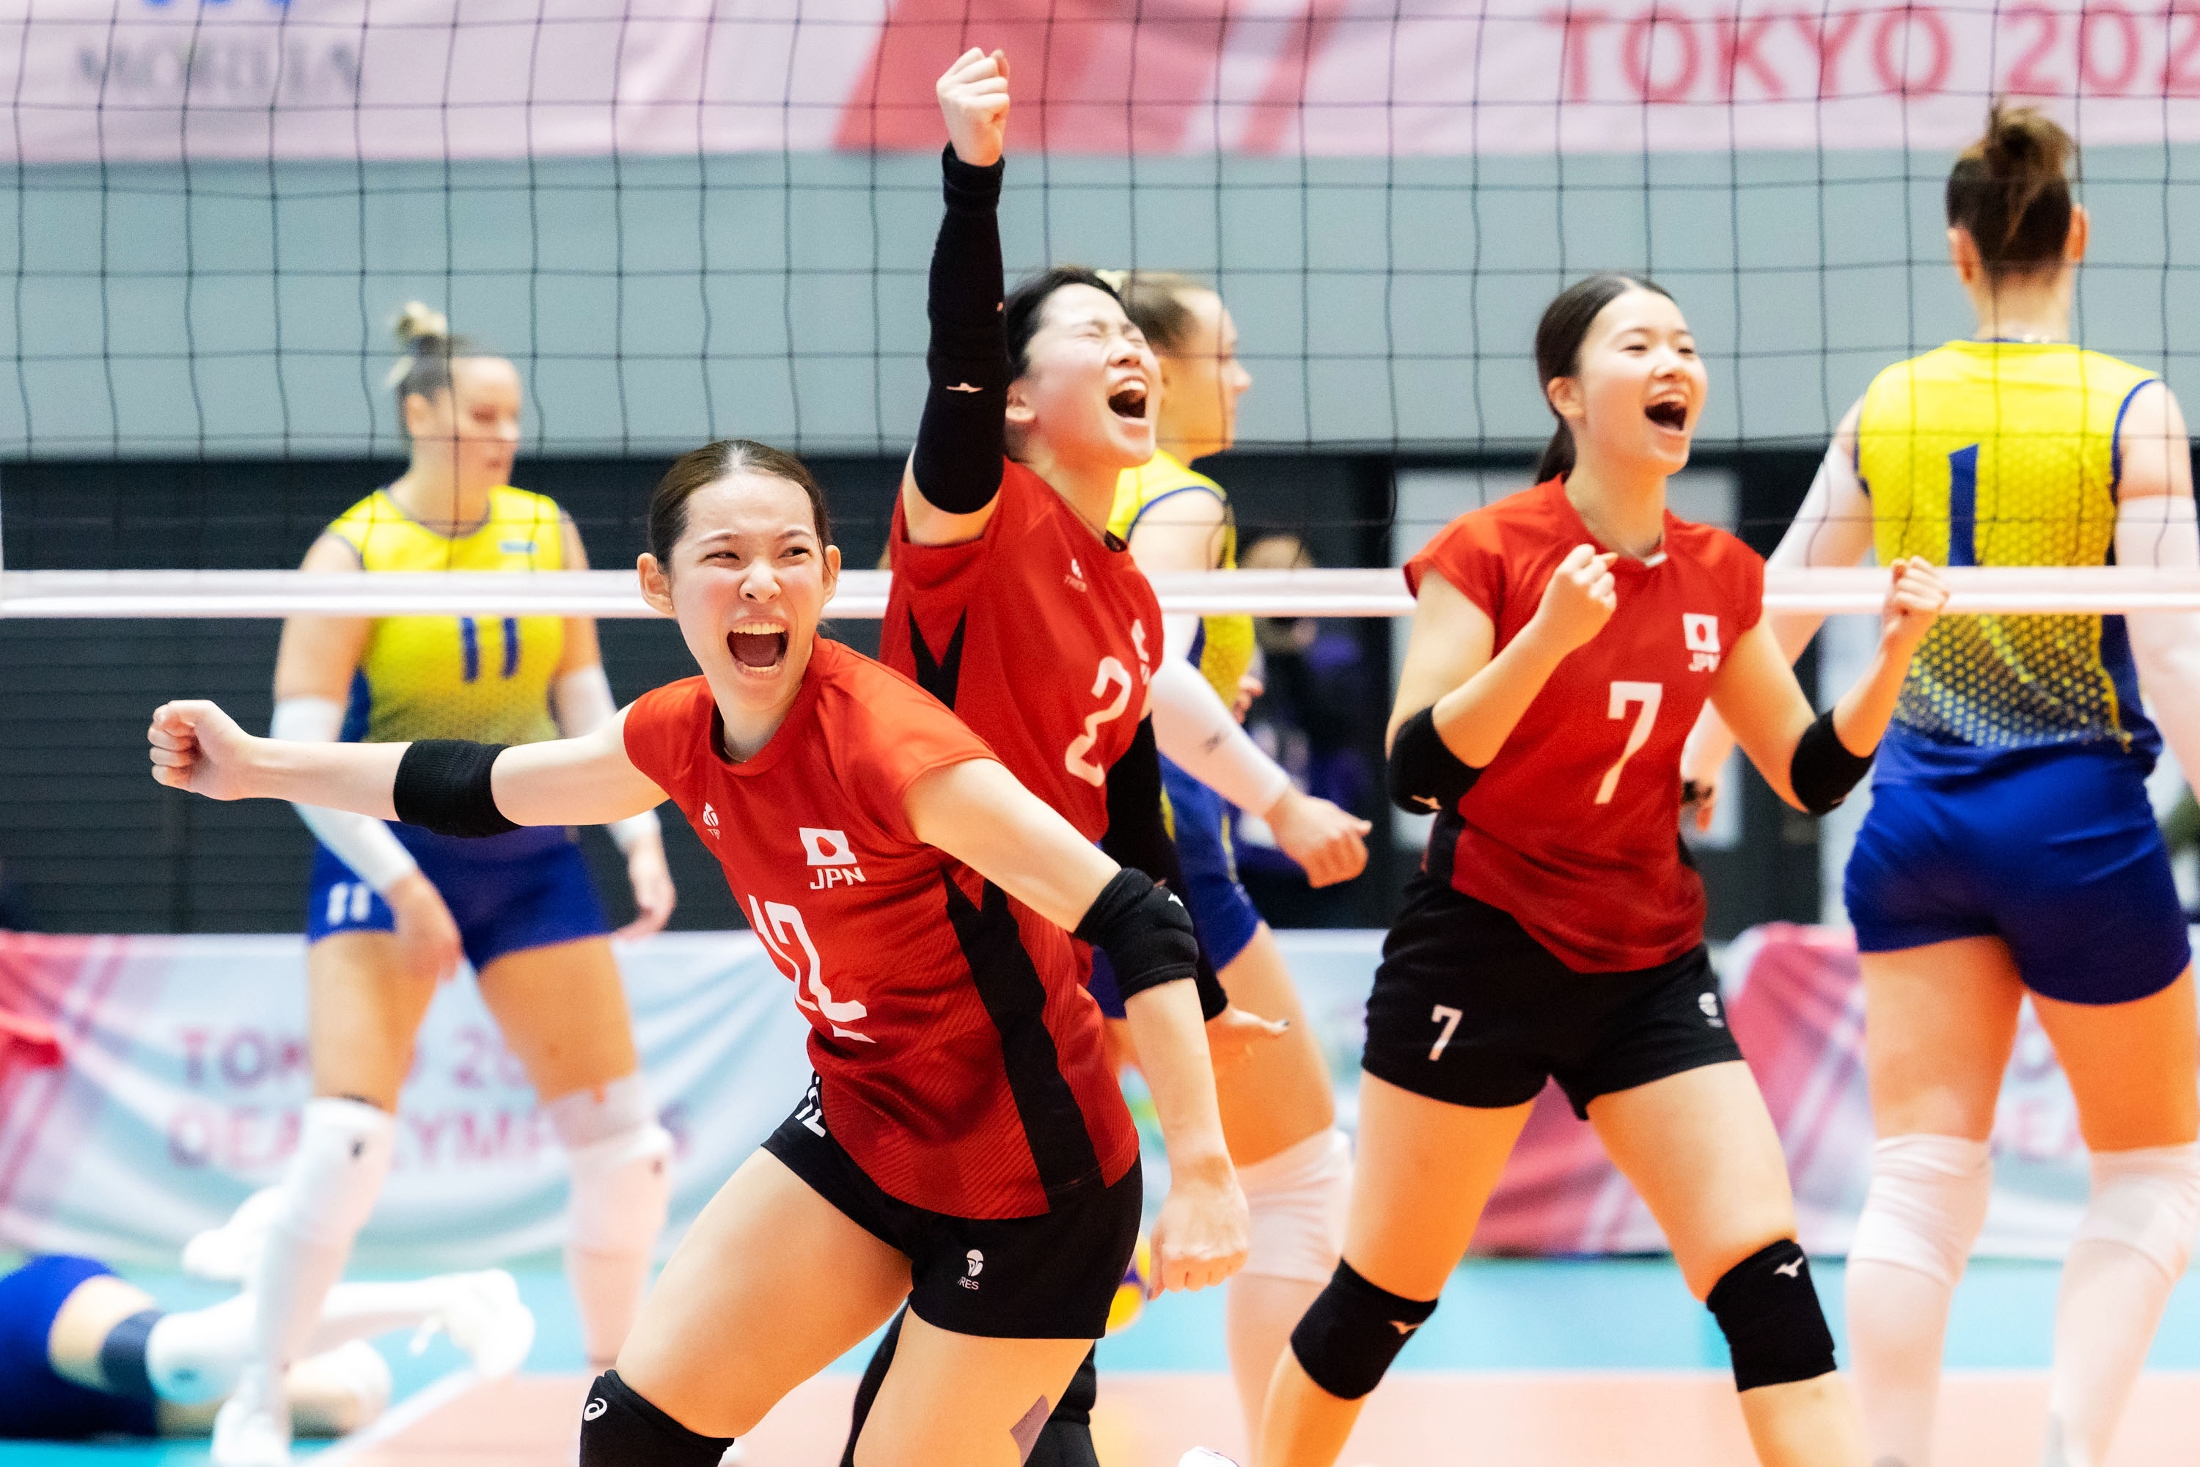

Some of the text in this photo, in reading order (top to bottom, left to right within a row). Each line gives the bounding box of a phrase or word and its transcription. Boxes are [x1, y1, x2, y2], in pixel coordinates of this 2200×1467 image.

[1546, 6, 1952, 103] TOKYO
[1947, 443, 1979, 566] 1
[460, 616, 520, 683] 11
[1065, 656, 1132, 787] 2
[1595, 681, 1663, 804] 7
[326, 882, 372, 926] 11
[809, 867, 867, 889] JPN
[1429, 1004, 1463, 1061] 7
[957, 1276, 979, 1290] RES
